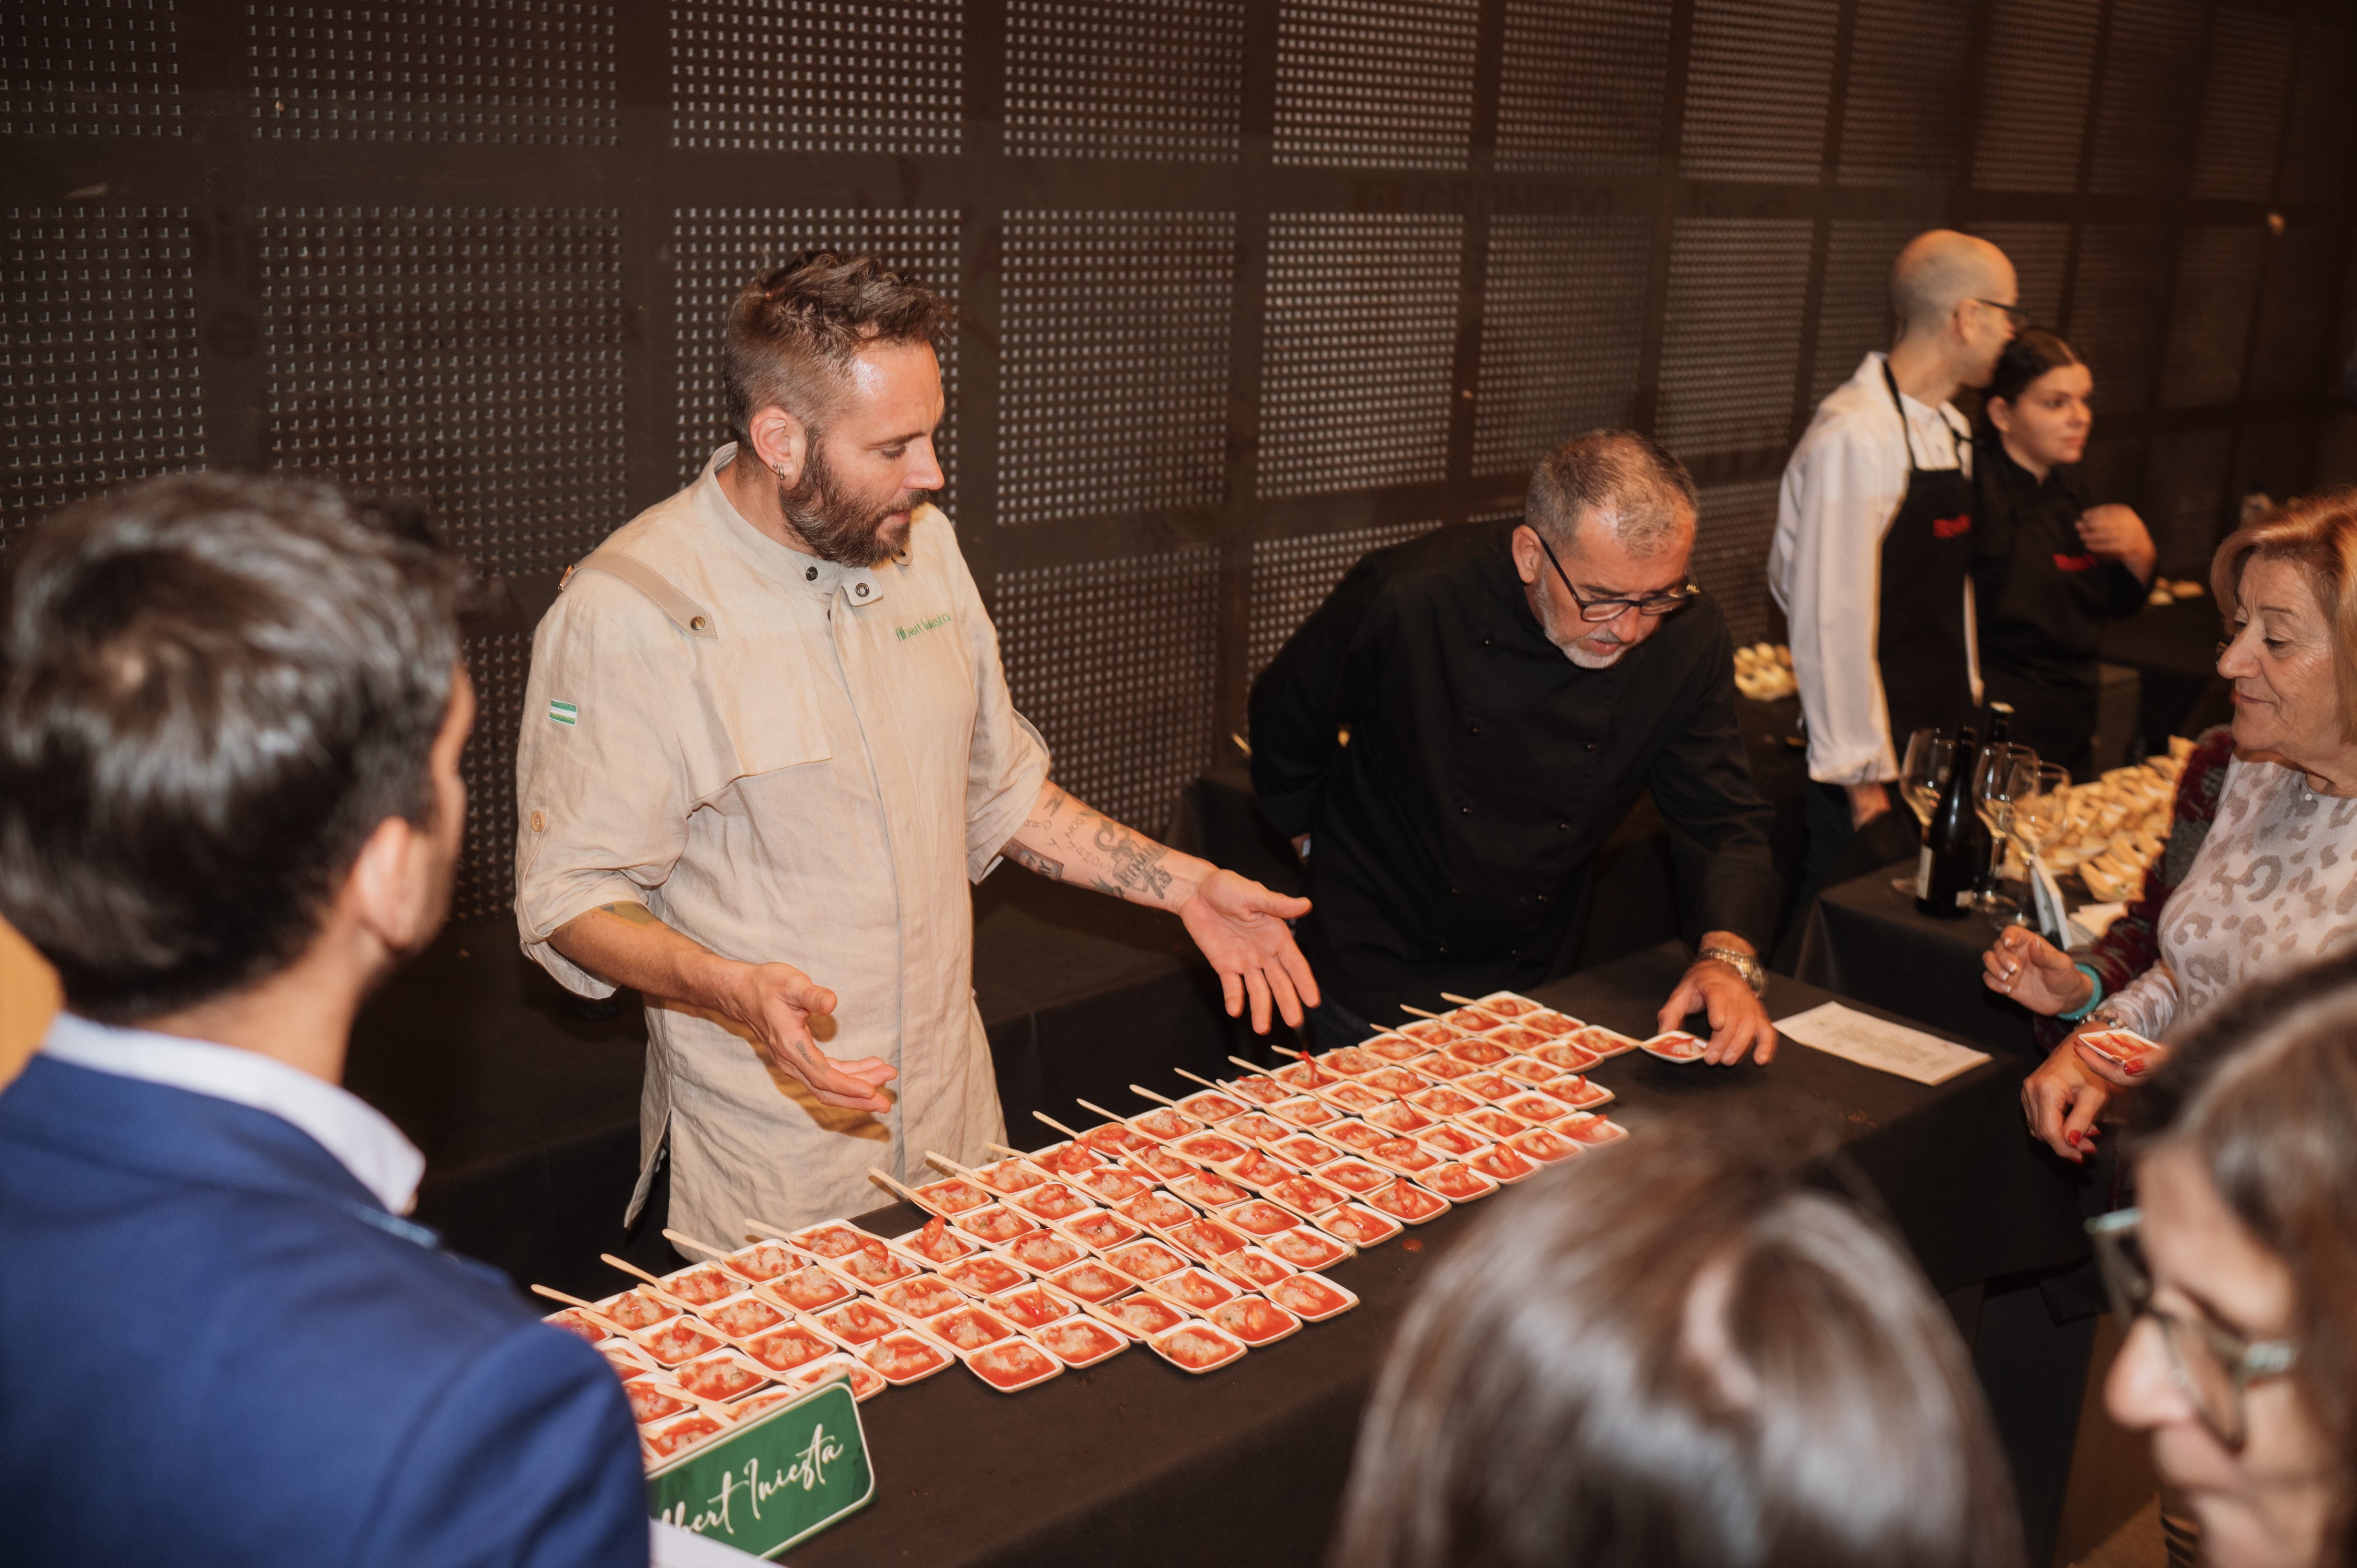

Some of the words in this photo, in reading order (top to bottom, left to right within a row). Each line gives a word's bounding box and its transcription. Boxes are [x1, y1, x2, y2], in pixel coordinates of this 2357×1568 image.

[895, 621, 924, 642] Albert
[661, 1470, 750, 1534] bert
[743, 1423, 844, 1520] Iniesta
